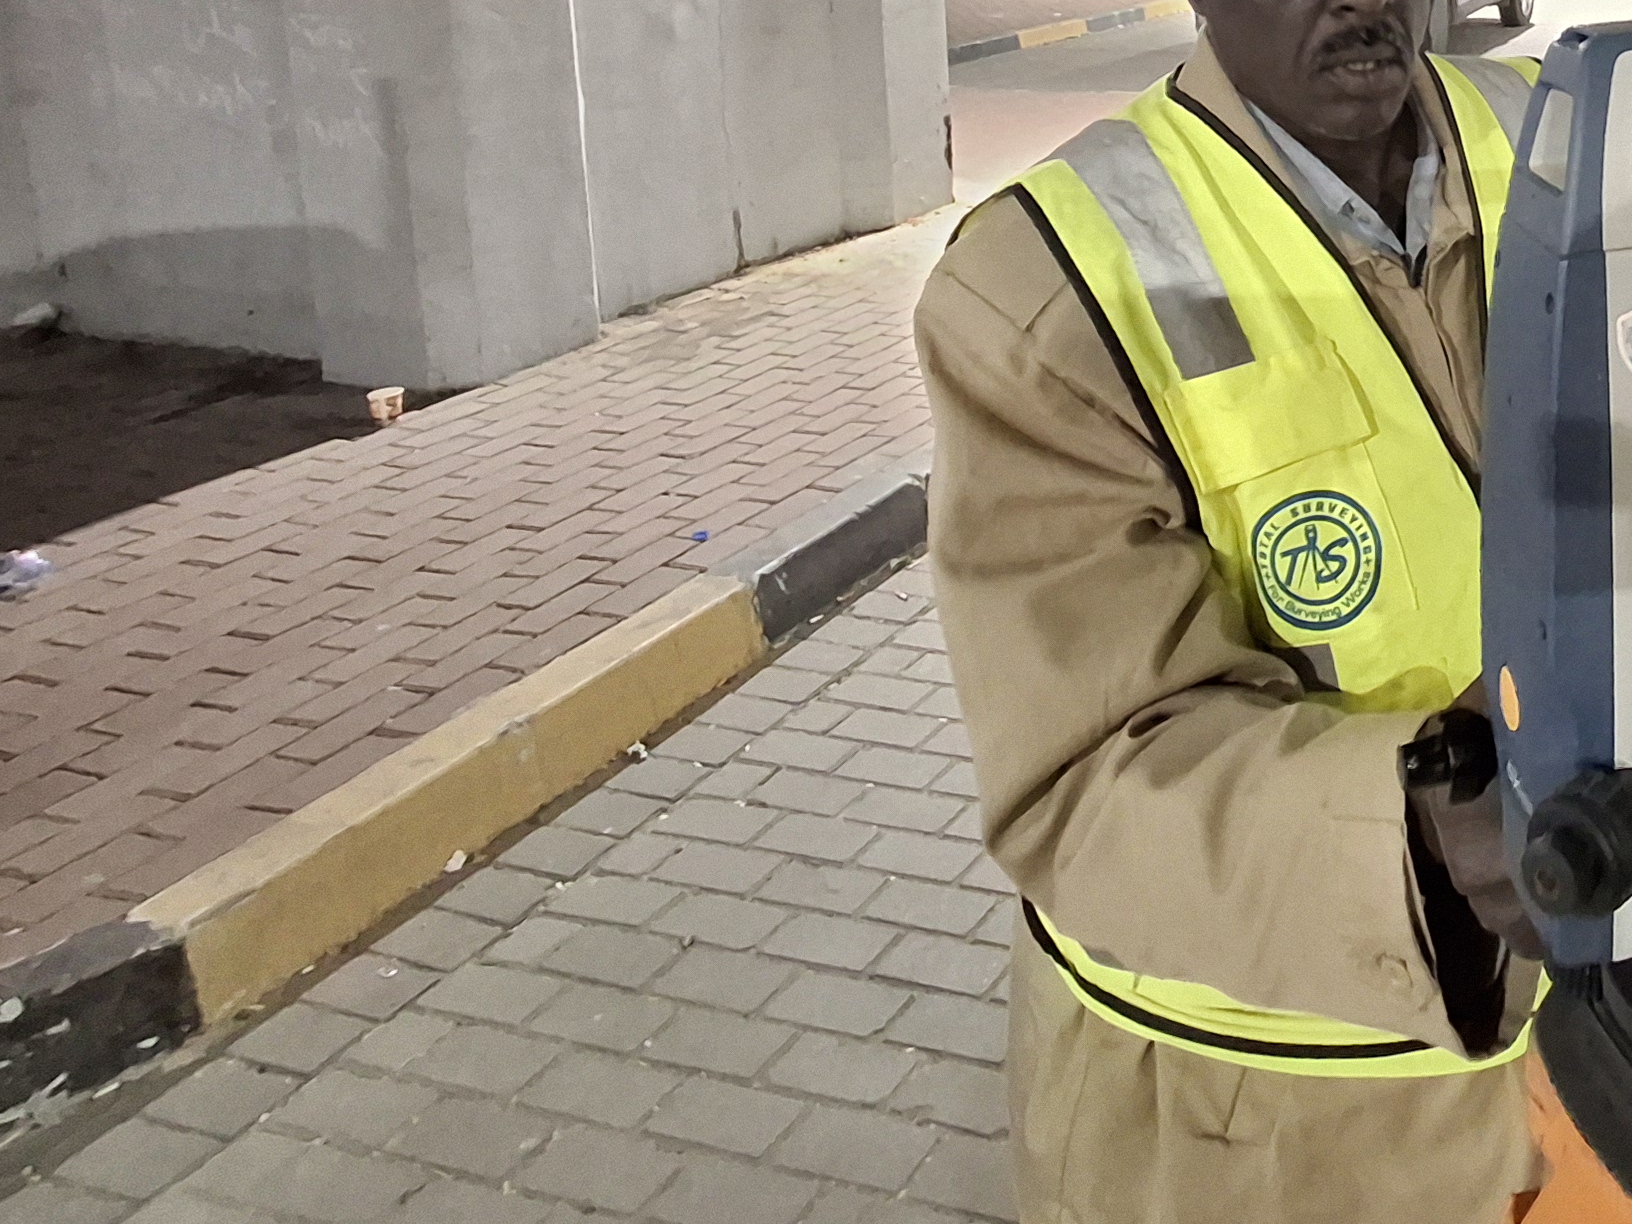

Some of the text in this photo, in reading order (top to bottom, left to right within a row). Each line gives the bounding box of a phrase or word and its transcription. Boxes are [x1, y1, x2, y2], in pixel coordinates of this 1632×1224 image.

[1257, 500, 1373, 570] TOTAL SURVEYING
[1267, 570, 1372, 622] For Surveying Works
